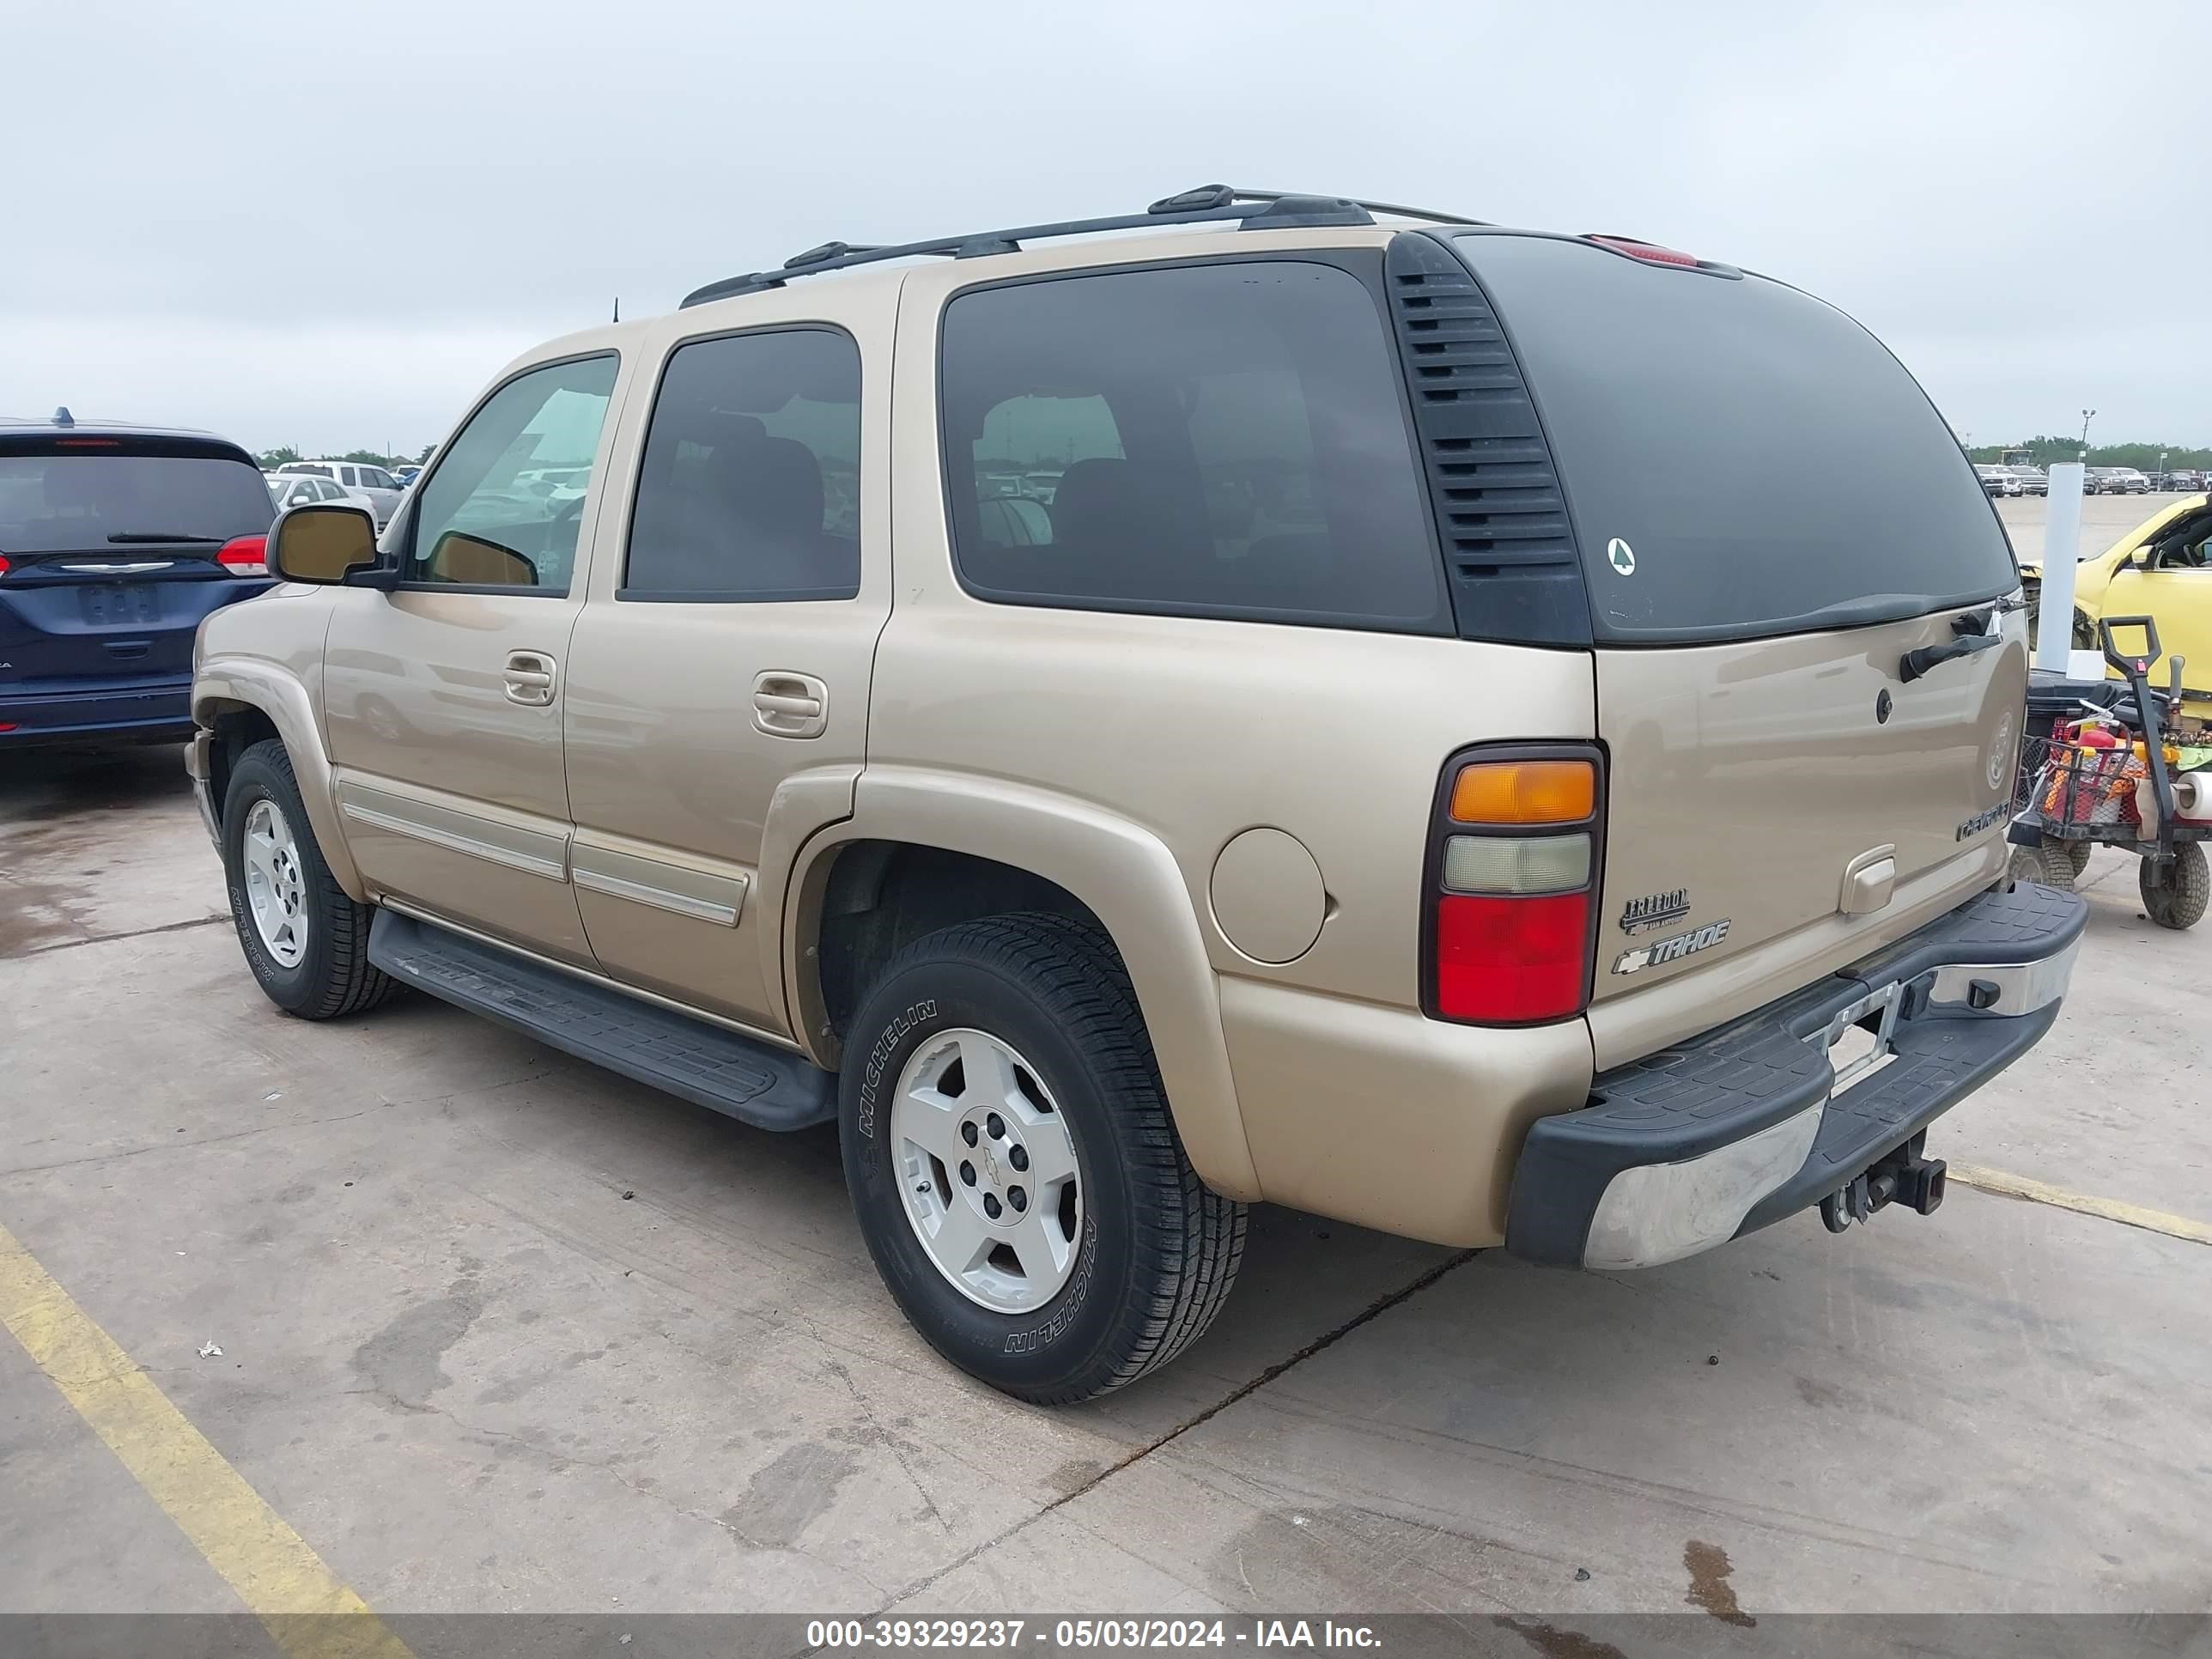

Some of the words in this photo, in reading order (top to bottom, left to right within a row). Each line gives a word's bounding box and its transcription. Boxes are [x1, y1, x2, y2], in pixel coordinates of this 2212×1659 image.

[1626, 887, 1691, 919] FREEDOM
[1653, 920, 1730, 964] TAHOE
[859, 999, 939, 1139] MICHELIN
[1004, 1215, 1097, 1353] MICHELIN
